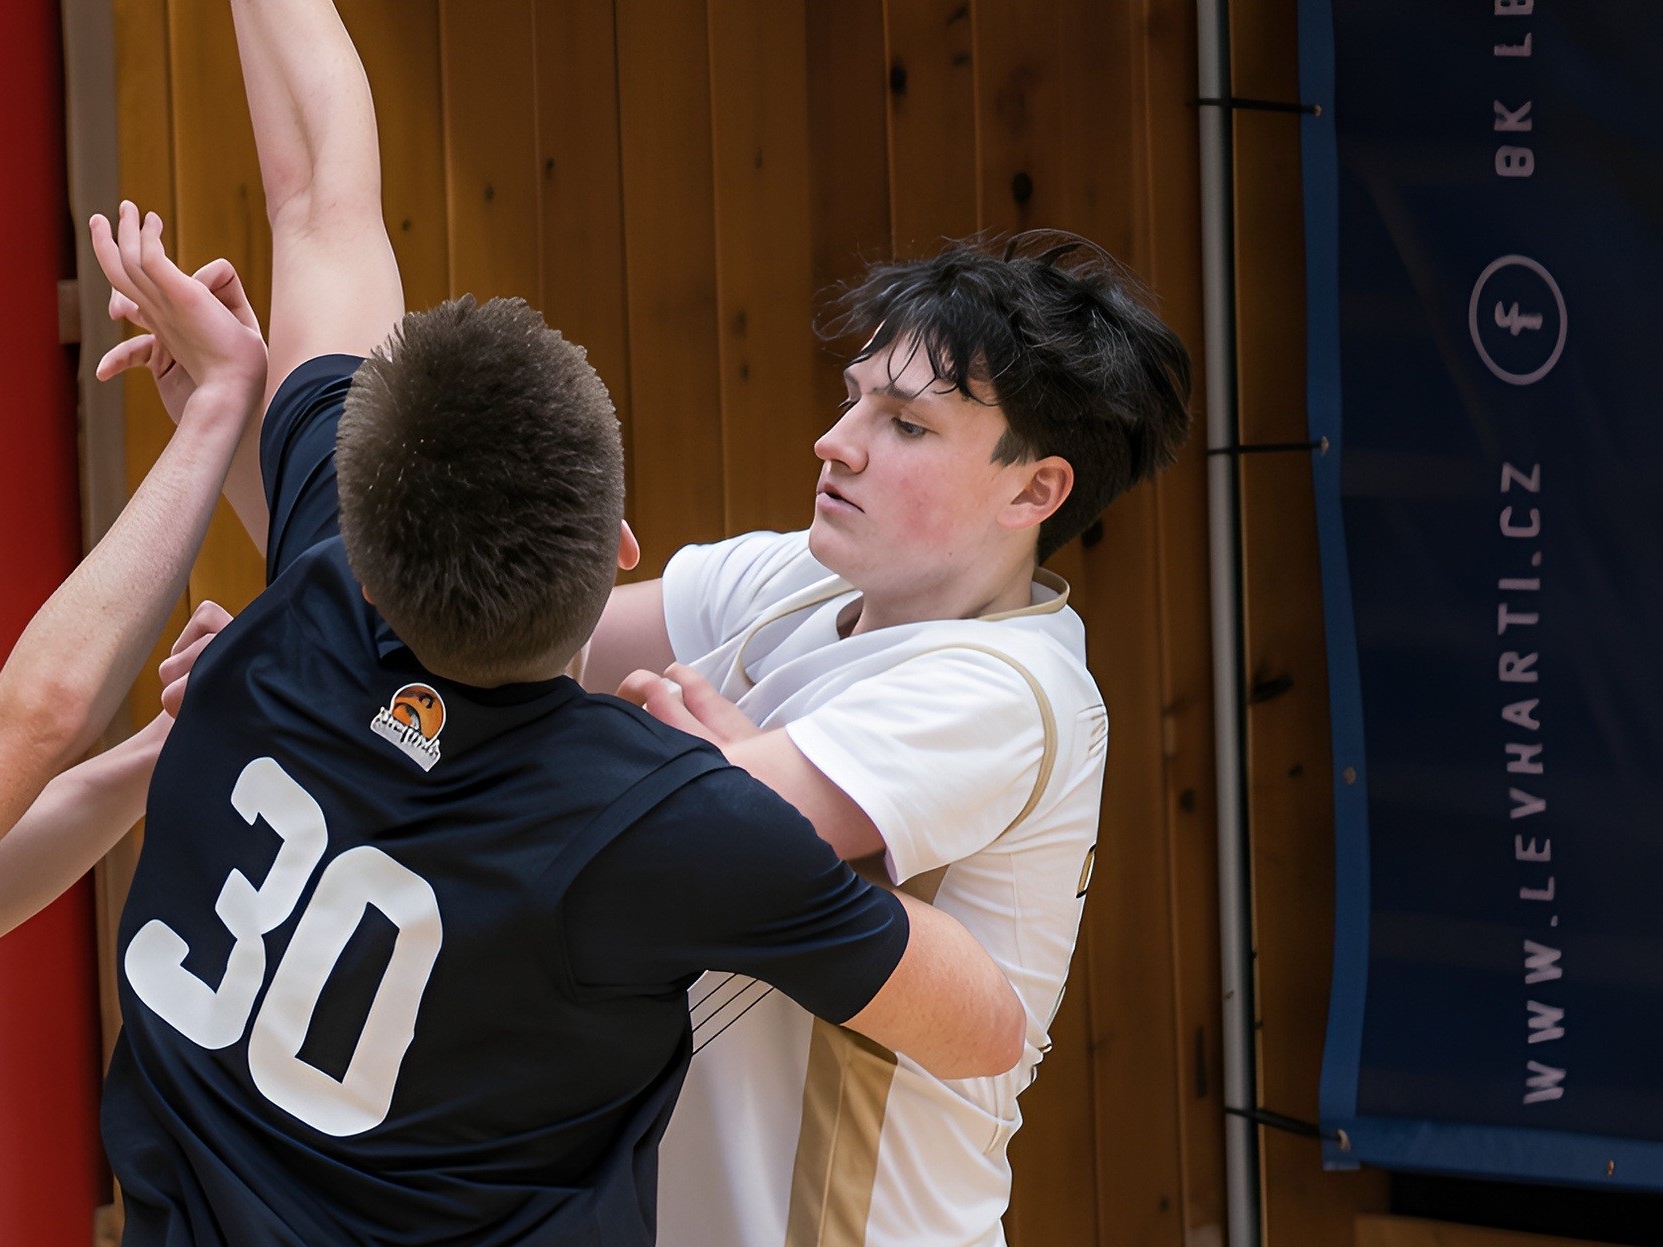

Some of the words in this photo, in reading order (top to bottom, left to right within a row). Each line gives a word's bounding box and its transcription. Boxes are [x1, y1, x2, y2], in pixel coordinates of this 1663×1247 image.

[1493, 99, 1535, 178] BK
[124, 756, 443, 1137] 30
[1497, 462, 1567, 1105] WWW.LEVHARTI.CZ
